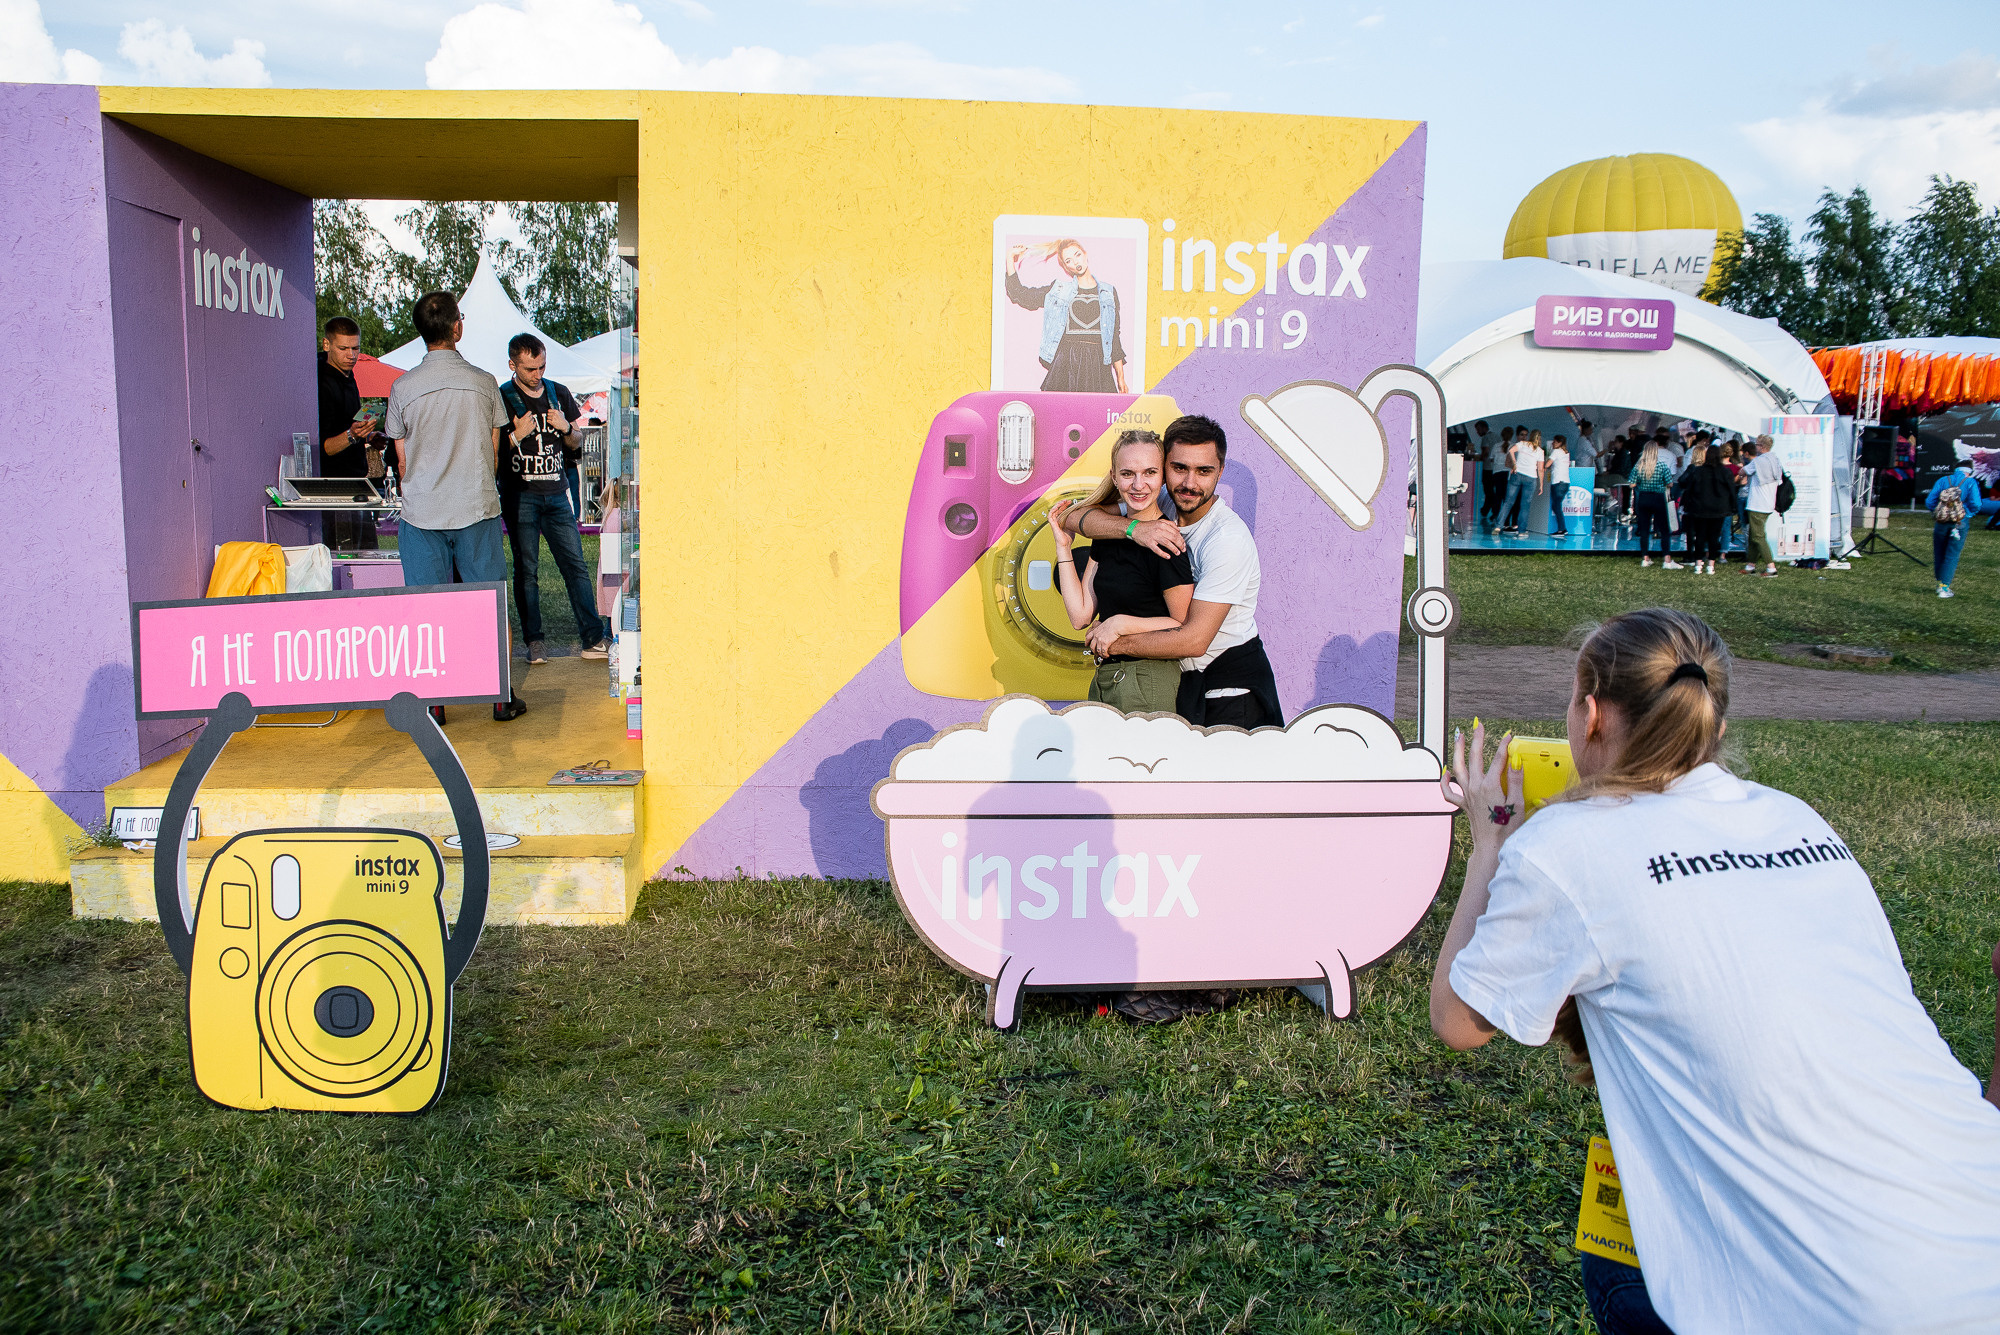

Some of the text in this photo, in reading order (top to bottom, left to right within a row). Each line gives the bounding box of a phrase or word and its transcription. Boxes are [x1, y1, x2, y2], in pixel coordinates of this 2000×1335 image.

[192, 226, 285, 320] instax
[1161, 218, 1371, 299] instax
[1560, 256, 1708, 276] IFLAME
[1160, 306, 1308, 350] mini 9
[1553, 305, 1660, 329] РИВ ГОШ
[1552, 329, 1586, 337] КРАСОТА
[1604, 332, 1658, 340] ВДОХНОВЕНИЕ
[1106, 408, 1152, 425] instax
[1007, 511, 1048, 622] INSTAX LENS
[190, 623, 446, 687] Я НЕ ПОЛЯРОИД!
[125, 817, 136, 832] НЕ
[355, 854, 420, 877] instax
[941, 831, 1202, 921] instax
[1647, 836, 1853, 885] #instaxmini
[366, 879, 410, 895] mini 9
